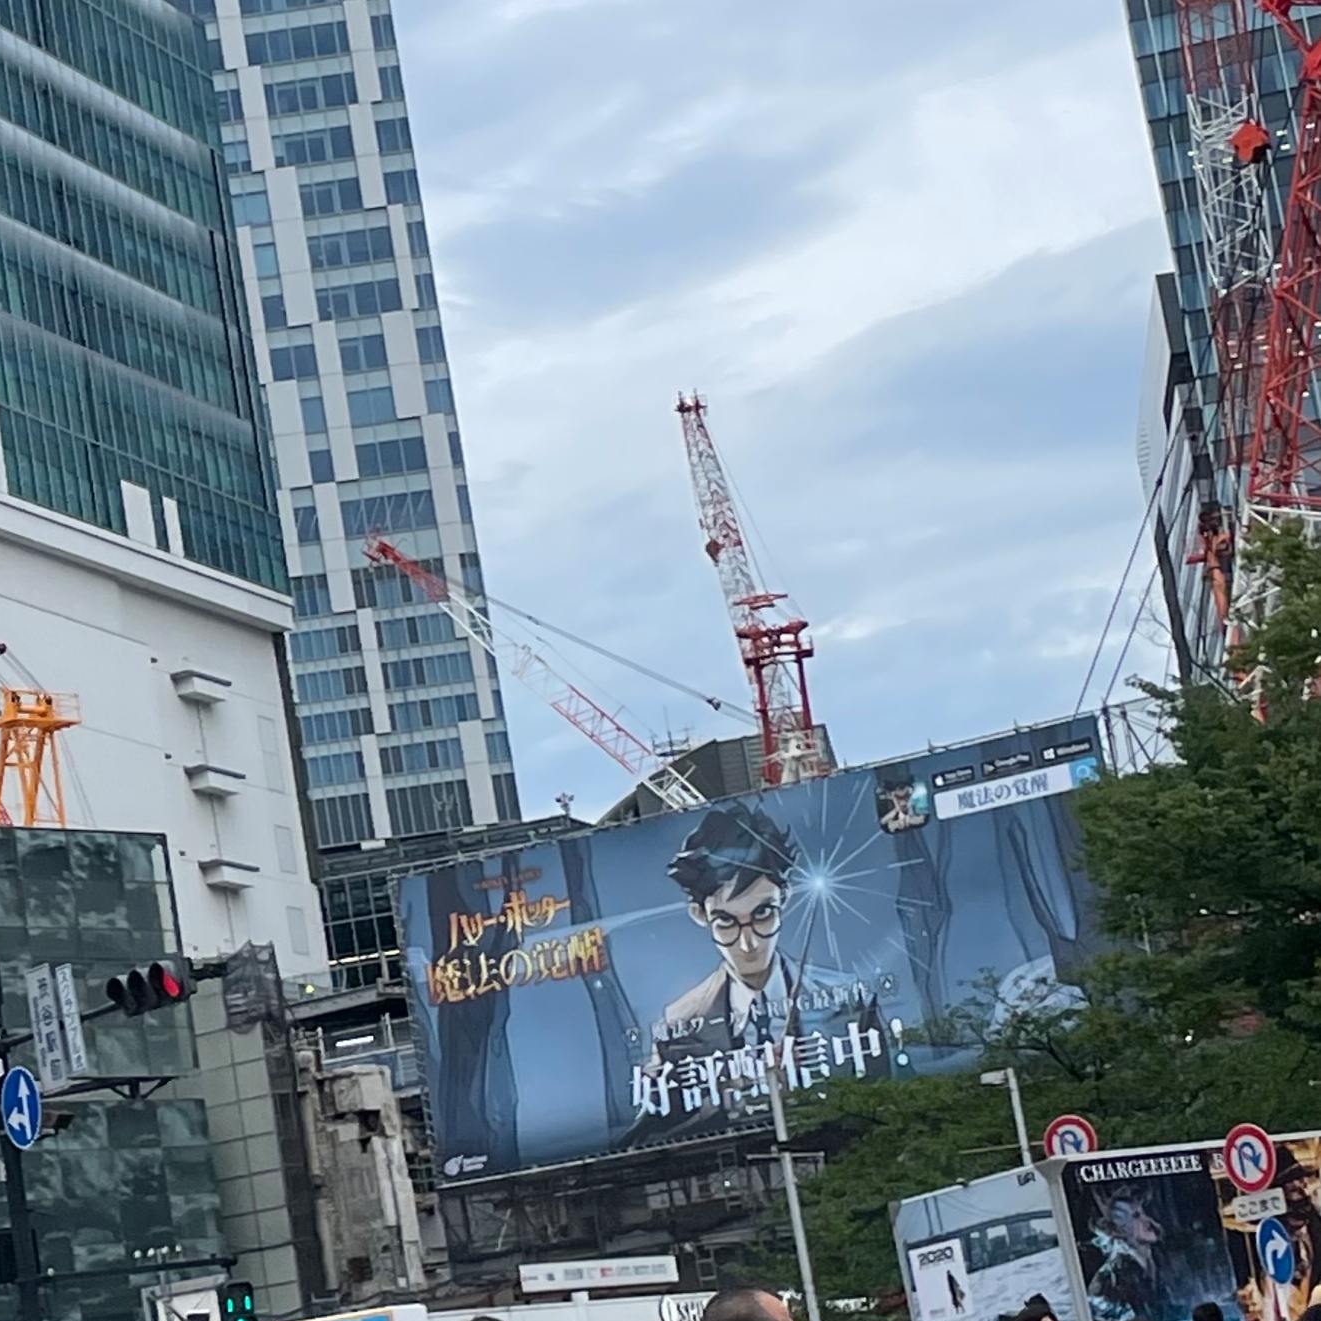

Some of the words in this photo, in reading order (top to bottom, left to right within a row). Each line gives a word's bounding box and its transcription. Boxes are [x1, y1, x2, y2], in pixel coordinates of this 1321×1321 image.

[956, 772, 1048, 811] 魔法の覚醒
[1236, 1195, 1285, 1219] ここまで
